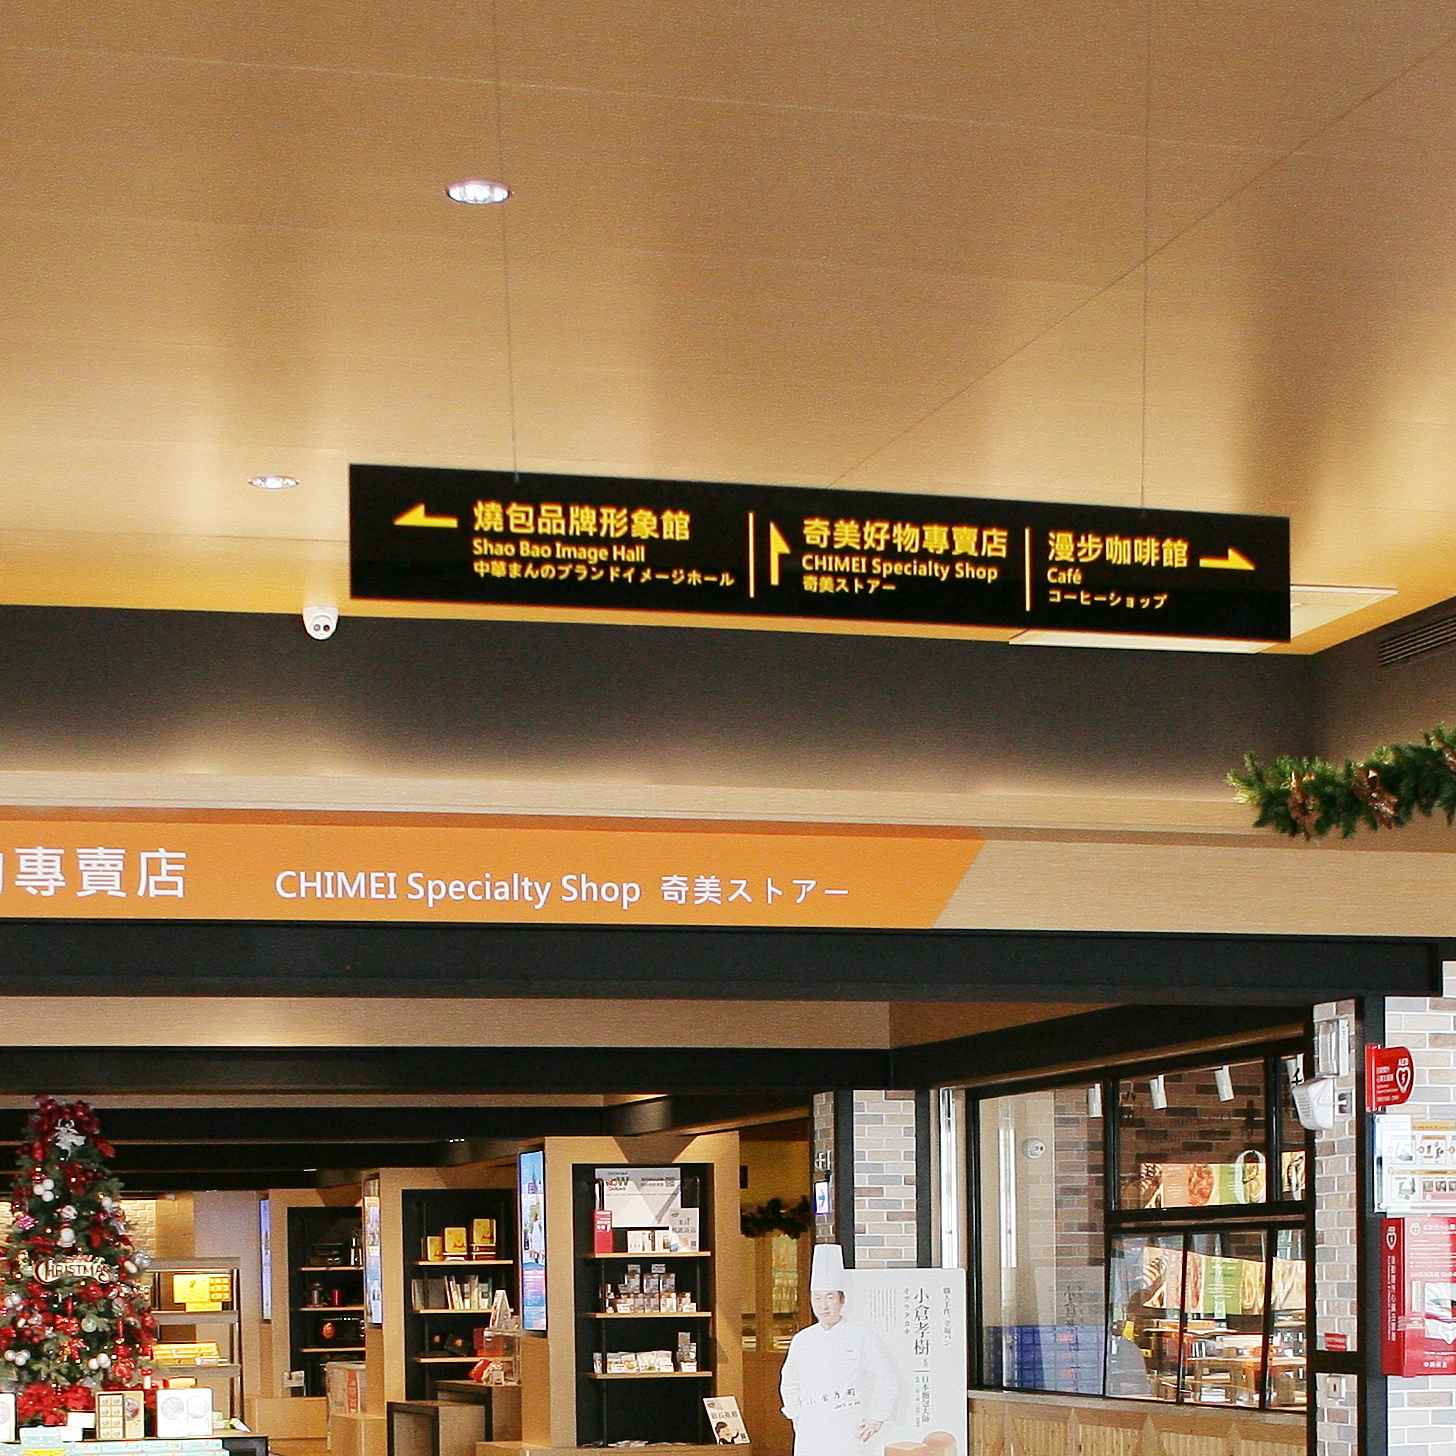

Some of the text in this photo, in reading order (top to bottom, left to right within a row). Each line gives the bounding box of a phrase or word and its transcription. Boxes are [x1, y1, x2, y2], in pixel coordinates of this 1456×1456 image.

[473, 500, 691, 541] 燒包品牌形象館
[802, 517, 1008, 558] 奇美好物專賣店
[473, 538, 645, 565] Shao Bao Image Hall
[1047, 531, 1189, 568] 漫步咖啡館
[801, 554, 998, 584] CHIMEI Specialty Shop
[1046, 567, 1083, 585] Café
[274, 870, 641, 909] CHIMEI Specialty Shop
[660, 874, 850, 906] 奇美ストアー
